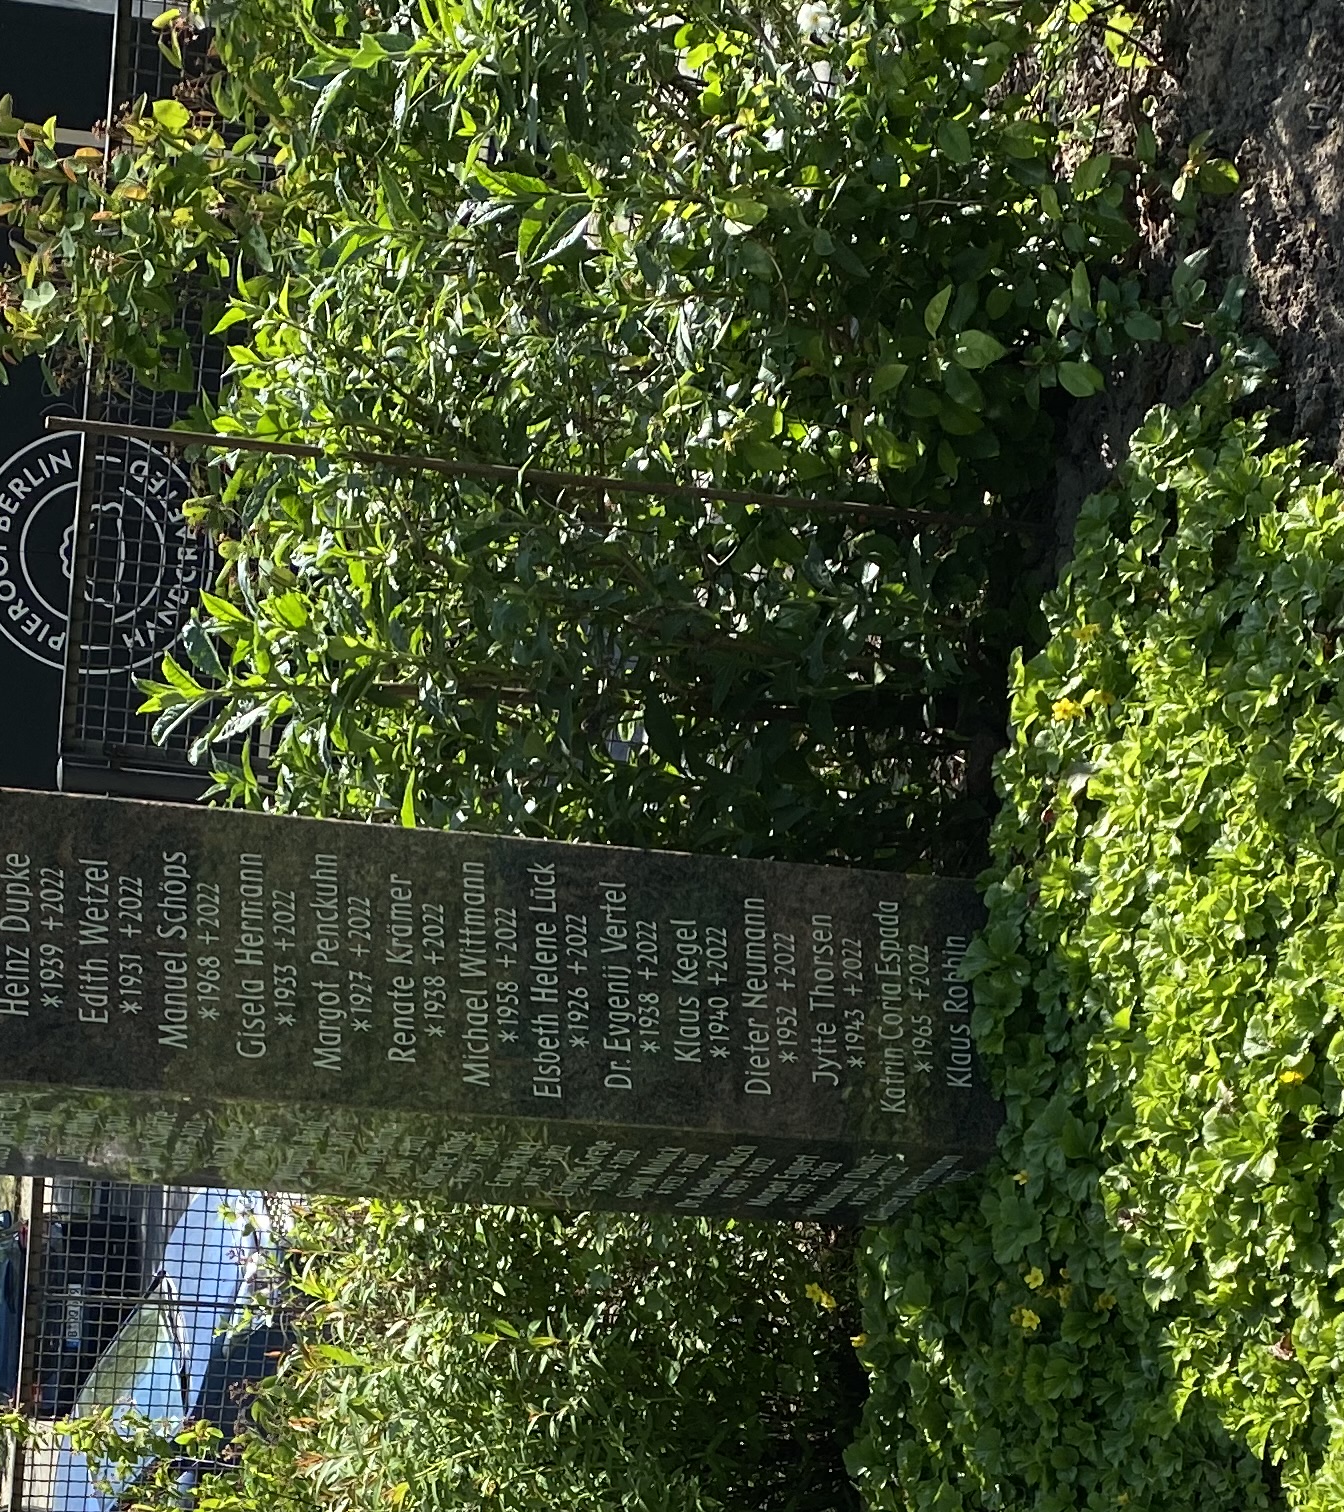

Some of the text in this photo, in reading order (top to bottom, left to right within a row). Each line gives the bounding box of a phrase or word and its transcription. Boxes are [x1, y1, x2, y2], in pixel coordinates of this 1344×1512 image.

[120, 459, 198, 650] HANDCRAFTED
[0, 853, 34, 932] Dupke
[79, 858, 110, 1023] Edith Wetzel
[157, 851, 191, 1048] Manuel Schöps
[235, 853, 267, 1057] Gisela Hermann
[310, 853, 348, 1070] Margot Penckuhn
[386, 873, 417, 1062] Renate Krämer
[459, 861, 491, 1086] Michael Wittmann
[527, 862, 562, 1097] Elsbeth Helene Lück
[599, 881, 637, 1089] Dr. Evgenij Vertel
[670, 919, 703, 1062] Klaus Kegel
[742, 898, 772, 1094] Dieter Neumann
[809, 914, 843, 1086] Jytte Thorsen
[873, 900, 907, 1112] Katrin Coria Espada
[947, 1024, 973, 1087] Klaus
